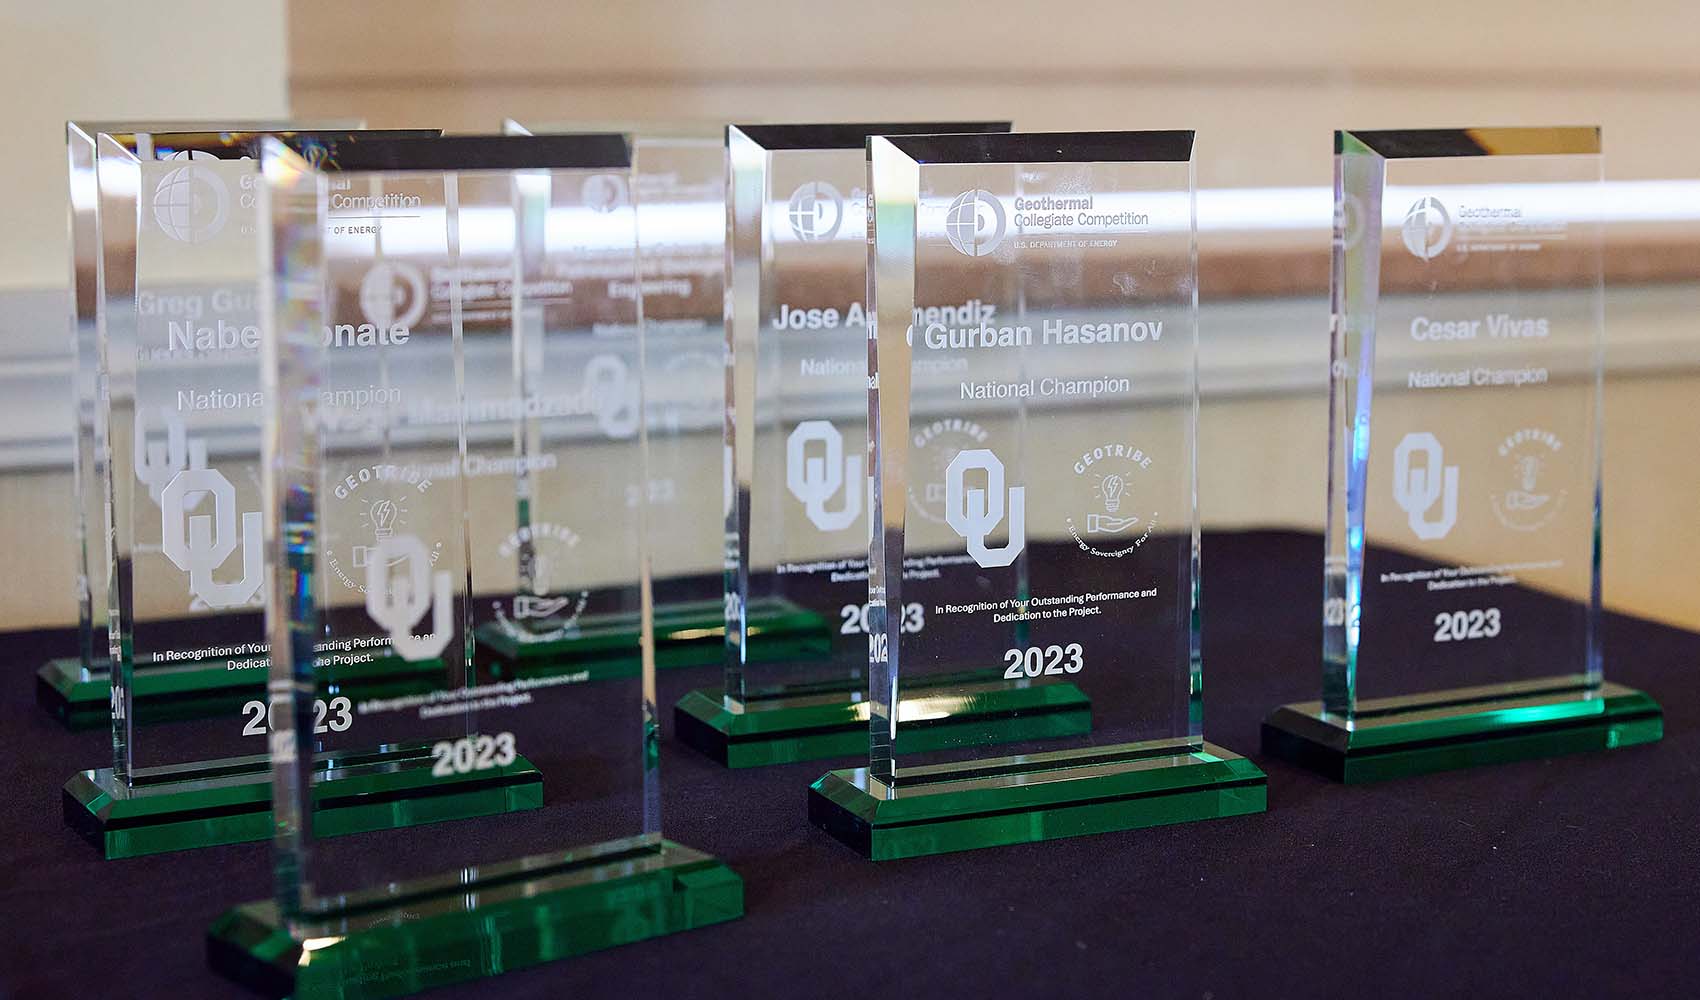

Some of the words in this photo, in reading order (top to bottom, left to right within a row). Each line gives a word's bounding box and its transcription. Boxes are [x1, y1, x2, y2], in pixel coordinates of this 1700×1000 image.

[332, 193, 421, 211] Competition
[1014, 196, 1093, 211] Geothermal
[334, 226, 345, 234] OF
[348, 226, 383, 234] ENERGY
[1014, 213, 1074, 229] Collegiate
[1078, 212, 1149, 228] Competition
[1014, 241, 1028, 249] U.S.
[771, 304, 839, 330] Jose
[1410, 316, 1480, 341] Cesar
[1486, 314, 1550, 338] Vivas
[925, 322, 1032, 349] Gurban
[1043, 319, 1163, 345] Hasanov
[960, 379, 1034, 400] National
[1040, 376, 1129, 398] Champion
[1408, 368, 1471, 388] National
[1472, 366, 1549, 387] Champion
[177, 388, 264, 411] Nationa
[1074, 444, 1153, 474] GEOTRIBE
[1135, 533, 1149, 547] For
[935, 604, 944, 614] In
[945, 602, 998, 614] Recognition
[1000, 600, 1009, 609] of
[1009, 599, 1030, 608] Your
[1031, 594, 1085, 606] Outstanding
[1085, 591, 1140, 602] Performance
[1141, 588, 1157, 597] and
[993, 612, 1041, 623] Dedication
[1042, 610, 1052, 618] to
[1053, 608, 1067, 618] the
[1069, 606, 1102, 617] Project.
[1433, 608, 1501, 642] 2023
[152, 651, 164, 662] In
[166, 647, 232, 660] Recognition
[234, 643, 246, 655] of
[333, 653, 375, 667] Project.
[1003, 642, 1084, 680] 2023
[432, 732, 516, 777] 2023
